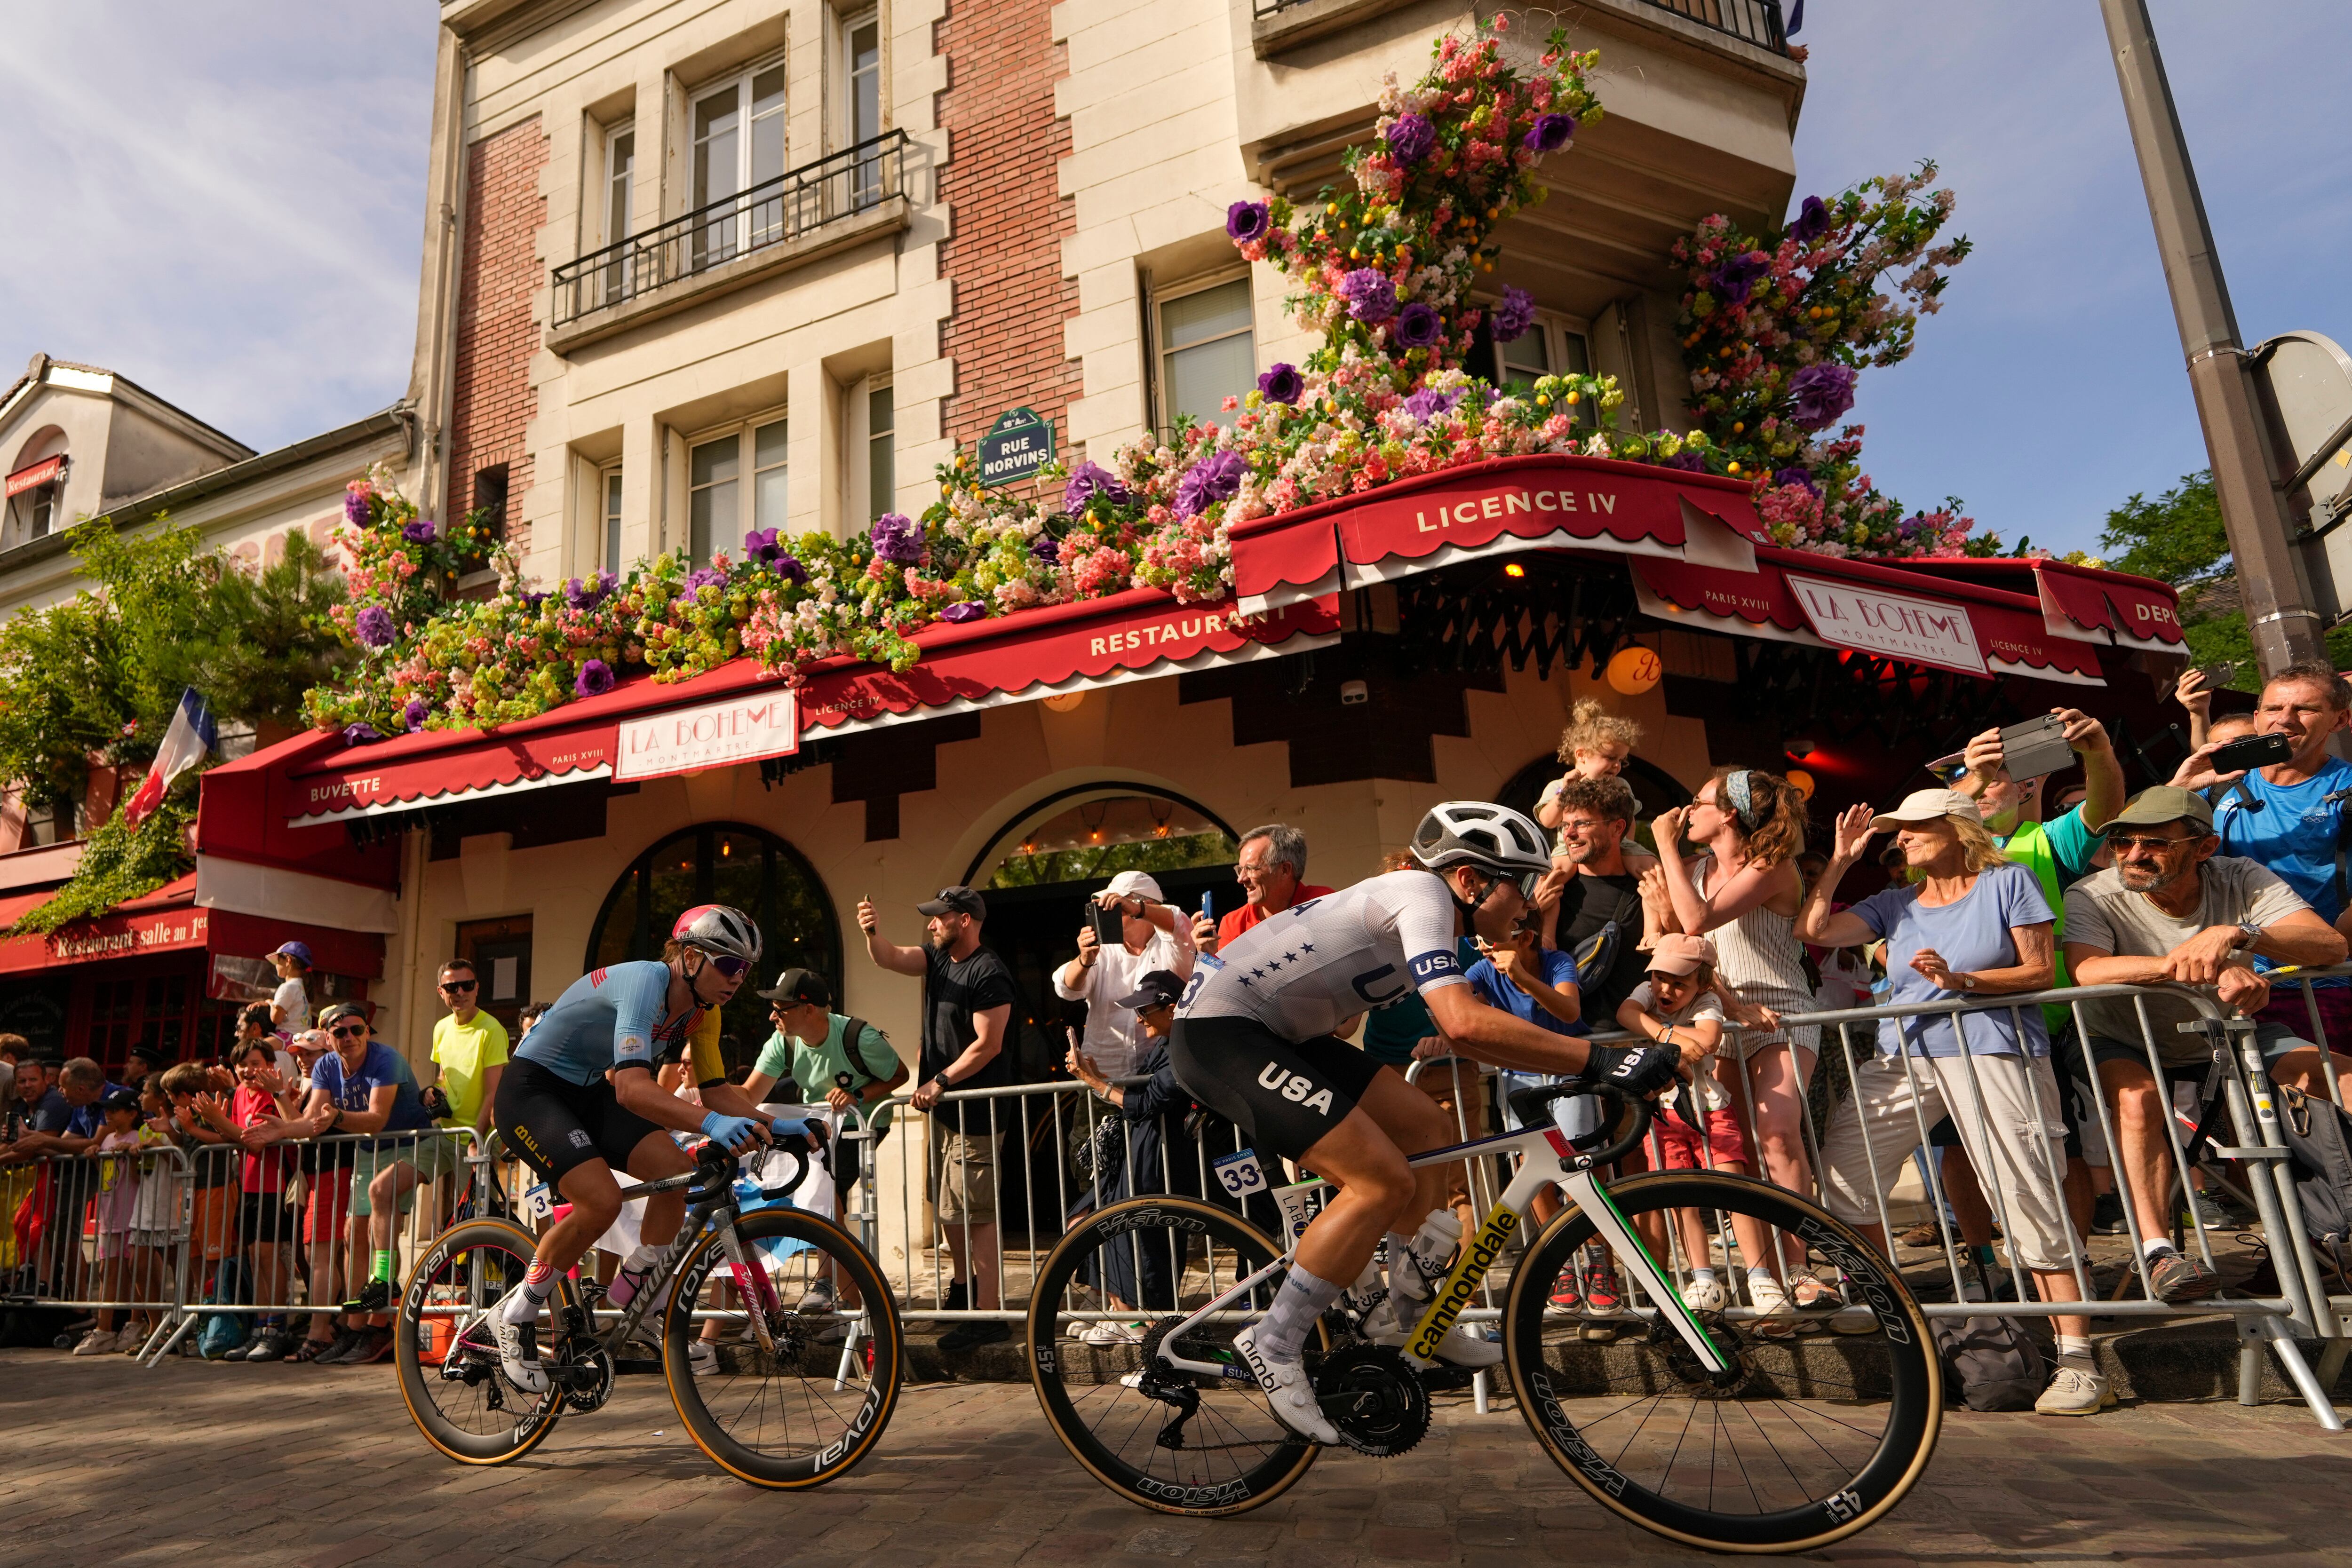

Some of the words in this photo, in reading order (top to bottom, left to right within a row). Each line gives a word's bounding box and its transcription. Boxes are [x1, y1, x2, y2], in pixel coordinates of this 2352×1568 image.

[1001, 437, 1030, 455] RUE
[985, 448, 1048, 475] NORVINS
[8, 465, 55, 494] Restaurant
[1416, 490, 1577, 533] LICENCE
[1588, 492, 1616, 515] IV
[1705, 590, 1737, 605] PARIS
[1741, 597, 1770, 611] XVIII
[1806, 589, 1850, 622] LA
[1855, 599, 1969, 645] BOHEME
[1990, 638, 2029, 654] LICENCE
[2033, 647, 2042, 656] IV
[815, 697, 864, 716] LICENCE
[869, 696, 880, 706] IV
[631, 727, 660, 755] LA
[676, 701, 782, 747] BOHEME
[552, 752, 577, 765] PARIS
[580, 749, 604, 760] XVIII
[310, 777, 380, 802] BUVETTE
[57, 928, 133, 958] Restaurant
[140, 922, 170, 946] salle
[174, 926, 186, 942] au
[675, 929, 724, 940] SPECIALIZED
[1415, 956, 1460, 976] USA
[1611, 1048, 1647, 1077] USA
[1258, 1061, 1334, 1116] USA
[514, 1125, 547, 1163] BEL
[652, 1175, 691, 1190] SPECIALIZED
[1224, 1164, 1260, 1192] 33
[535, 1196, 546, 1213] 3
[677, 1240, 726, 1313] rova
[1422, 1257, 1444, 1275] US
[405, 1243, 448, 1323] roval
[618, 1224, 694, 1338] S-WORKS
[1291, 1278, 1311, 1297] USA
[1413, 1212, 1518, 1359] cannondale
[739, 1268, 768, 1337] SPECIALIZED
[1038, 1350, 1055, 1373] 45
[1241, 1339, 1283, 1394] nimbl
[814, 1384, 881, 1473] roval
[1823, 1501, 1840, 1524] SL
[1827, 1490, 1862, 1521] 45
